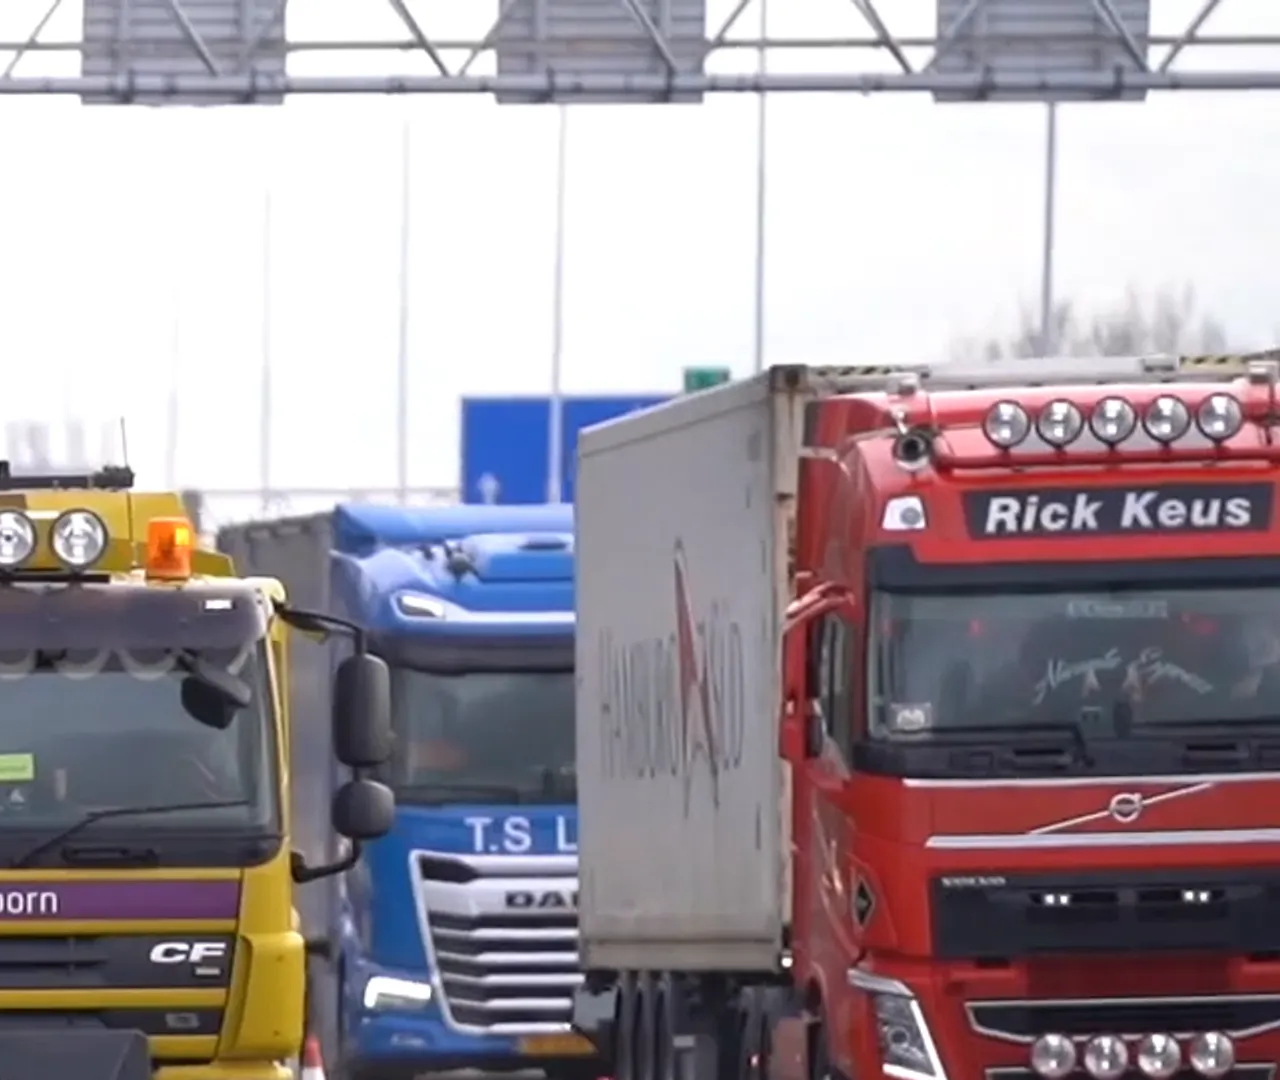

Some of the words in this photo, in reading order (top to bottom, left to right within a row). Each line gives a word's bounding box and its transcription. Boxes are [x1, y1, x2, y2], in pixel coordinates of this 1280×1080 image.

[985, 493, 1103, 534] Rick
[1120, 491, 1252, 528] Keus
[464, 816, 532, 852] T.S
[505, 890, 578, 909] DA
[150, 942, 226, 963] CF
